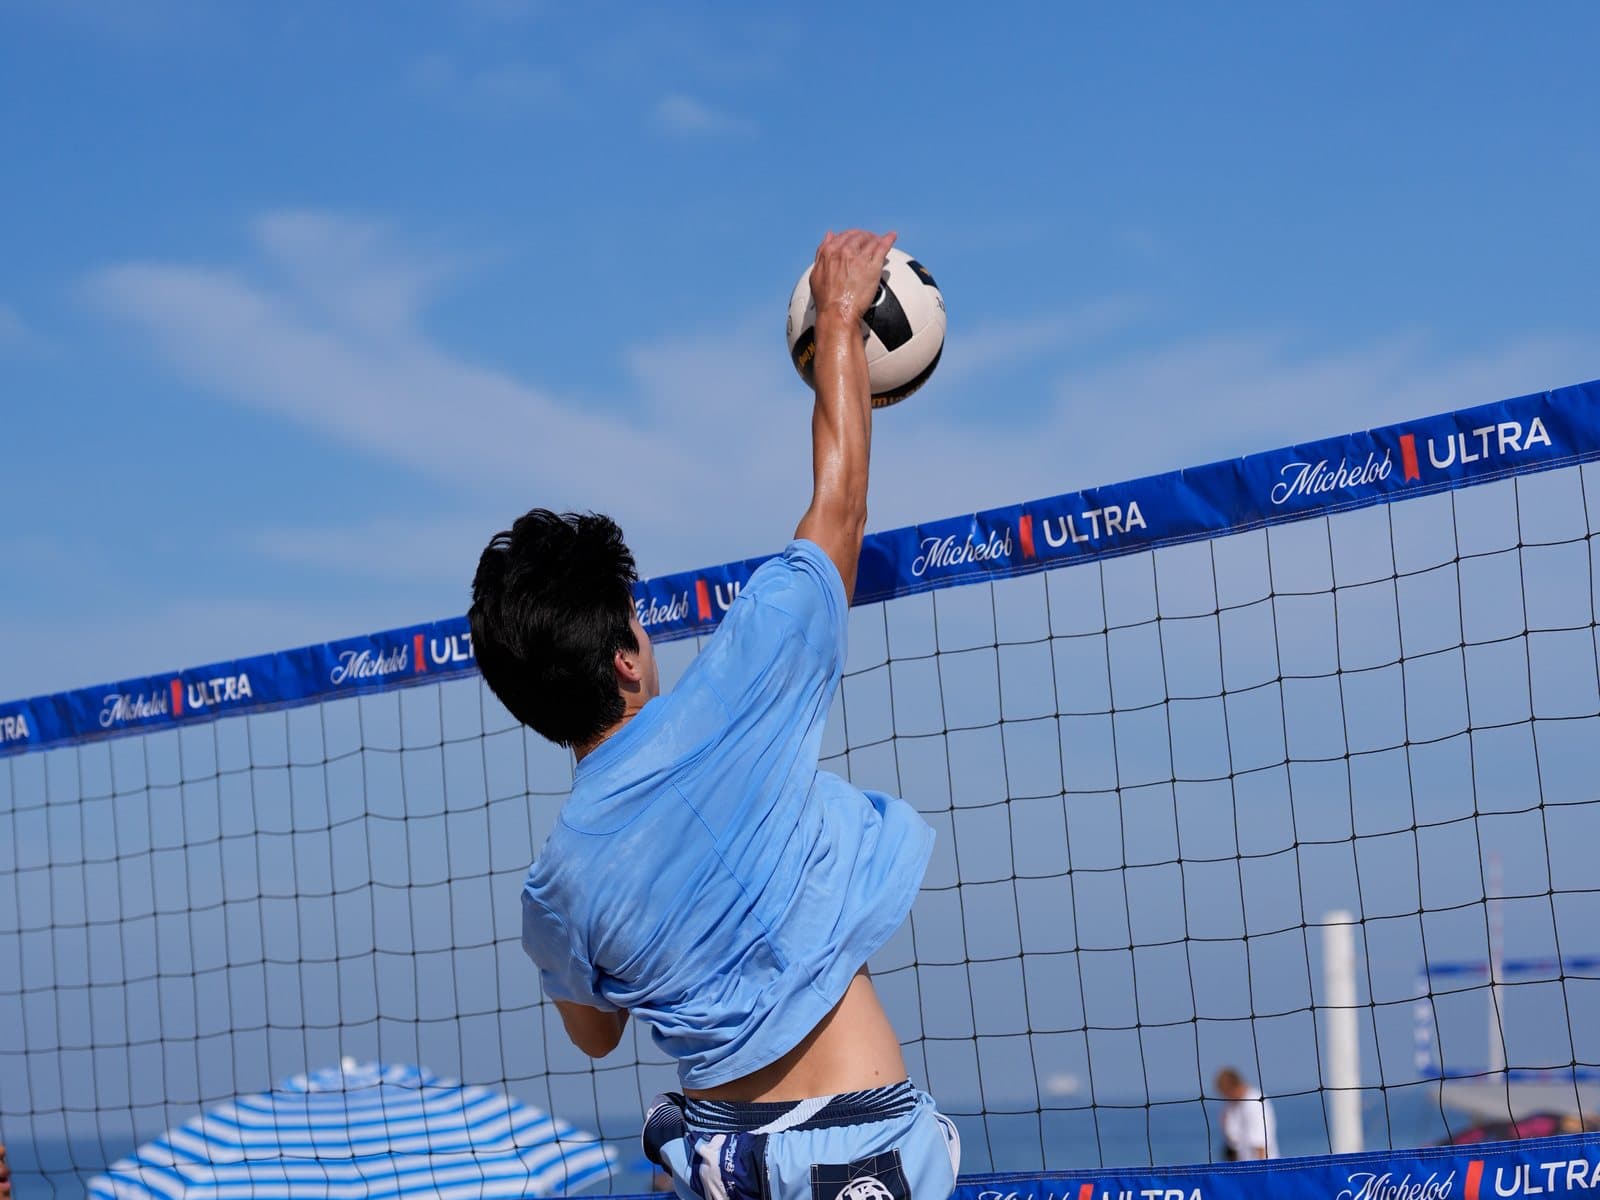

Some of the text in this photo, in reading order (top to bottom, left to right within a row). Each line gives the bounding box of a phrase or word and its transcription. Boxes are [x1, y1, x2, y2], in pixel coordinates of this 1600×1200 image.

[1270, 416, 1553, 505] Michelob ULTRA
[911, 500, 1148, 577] Michelob ULTRA
[634, 589, 689, 627] ichelob
[329, 632, 475, 686] Michelob ULT
[187, 673, 253, 709] ULTRA
